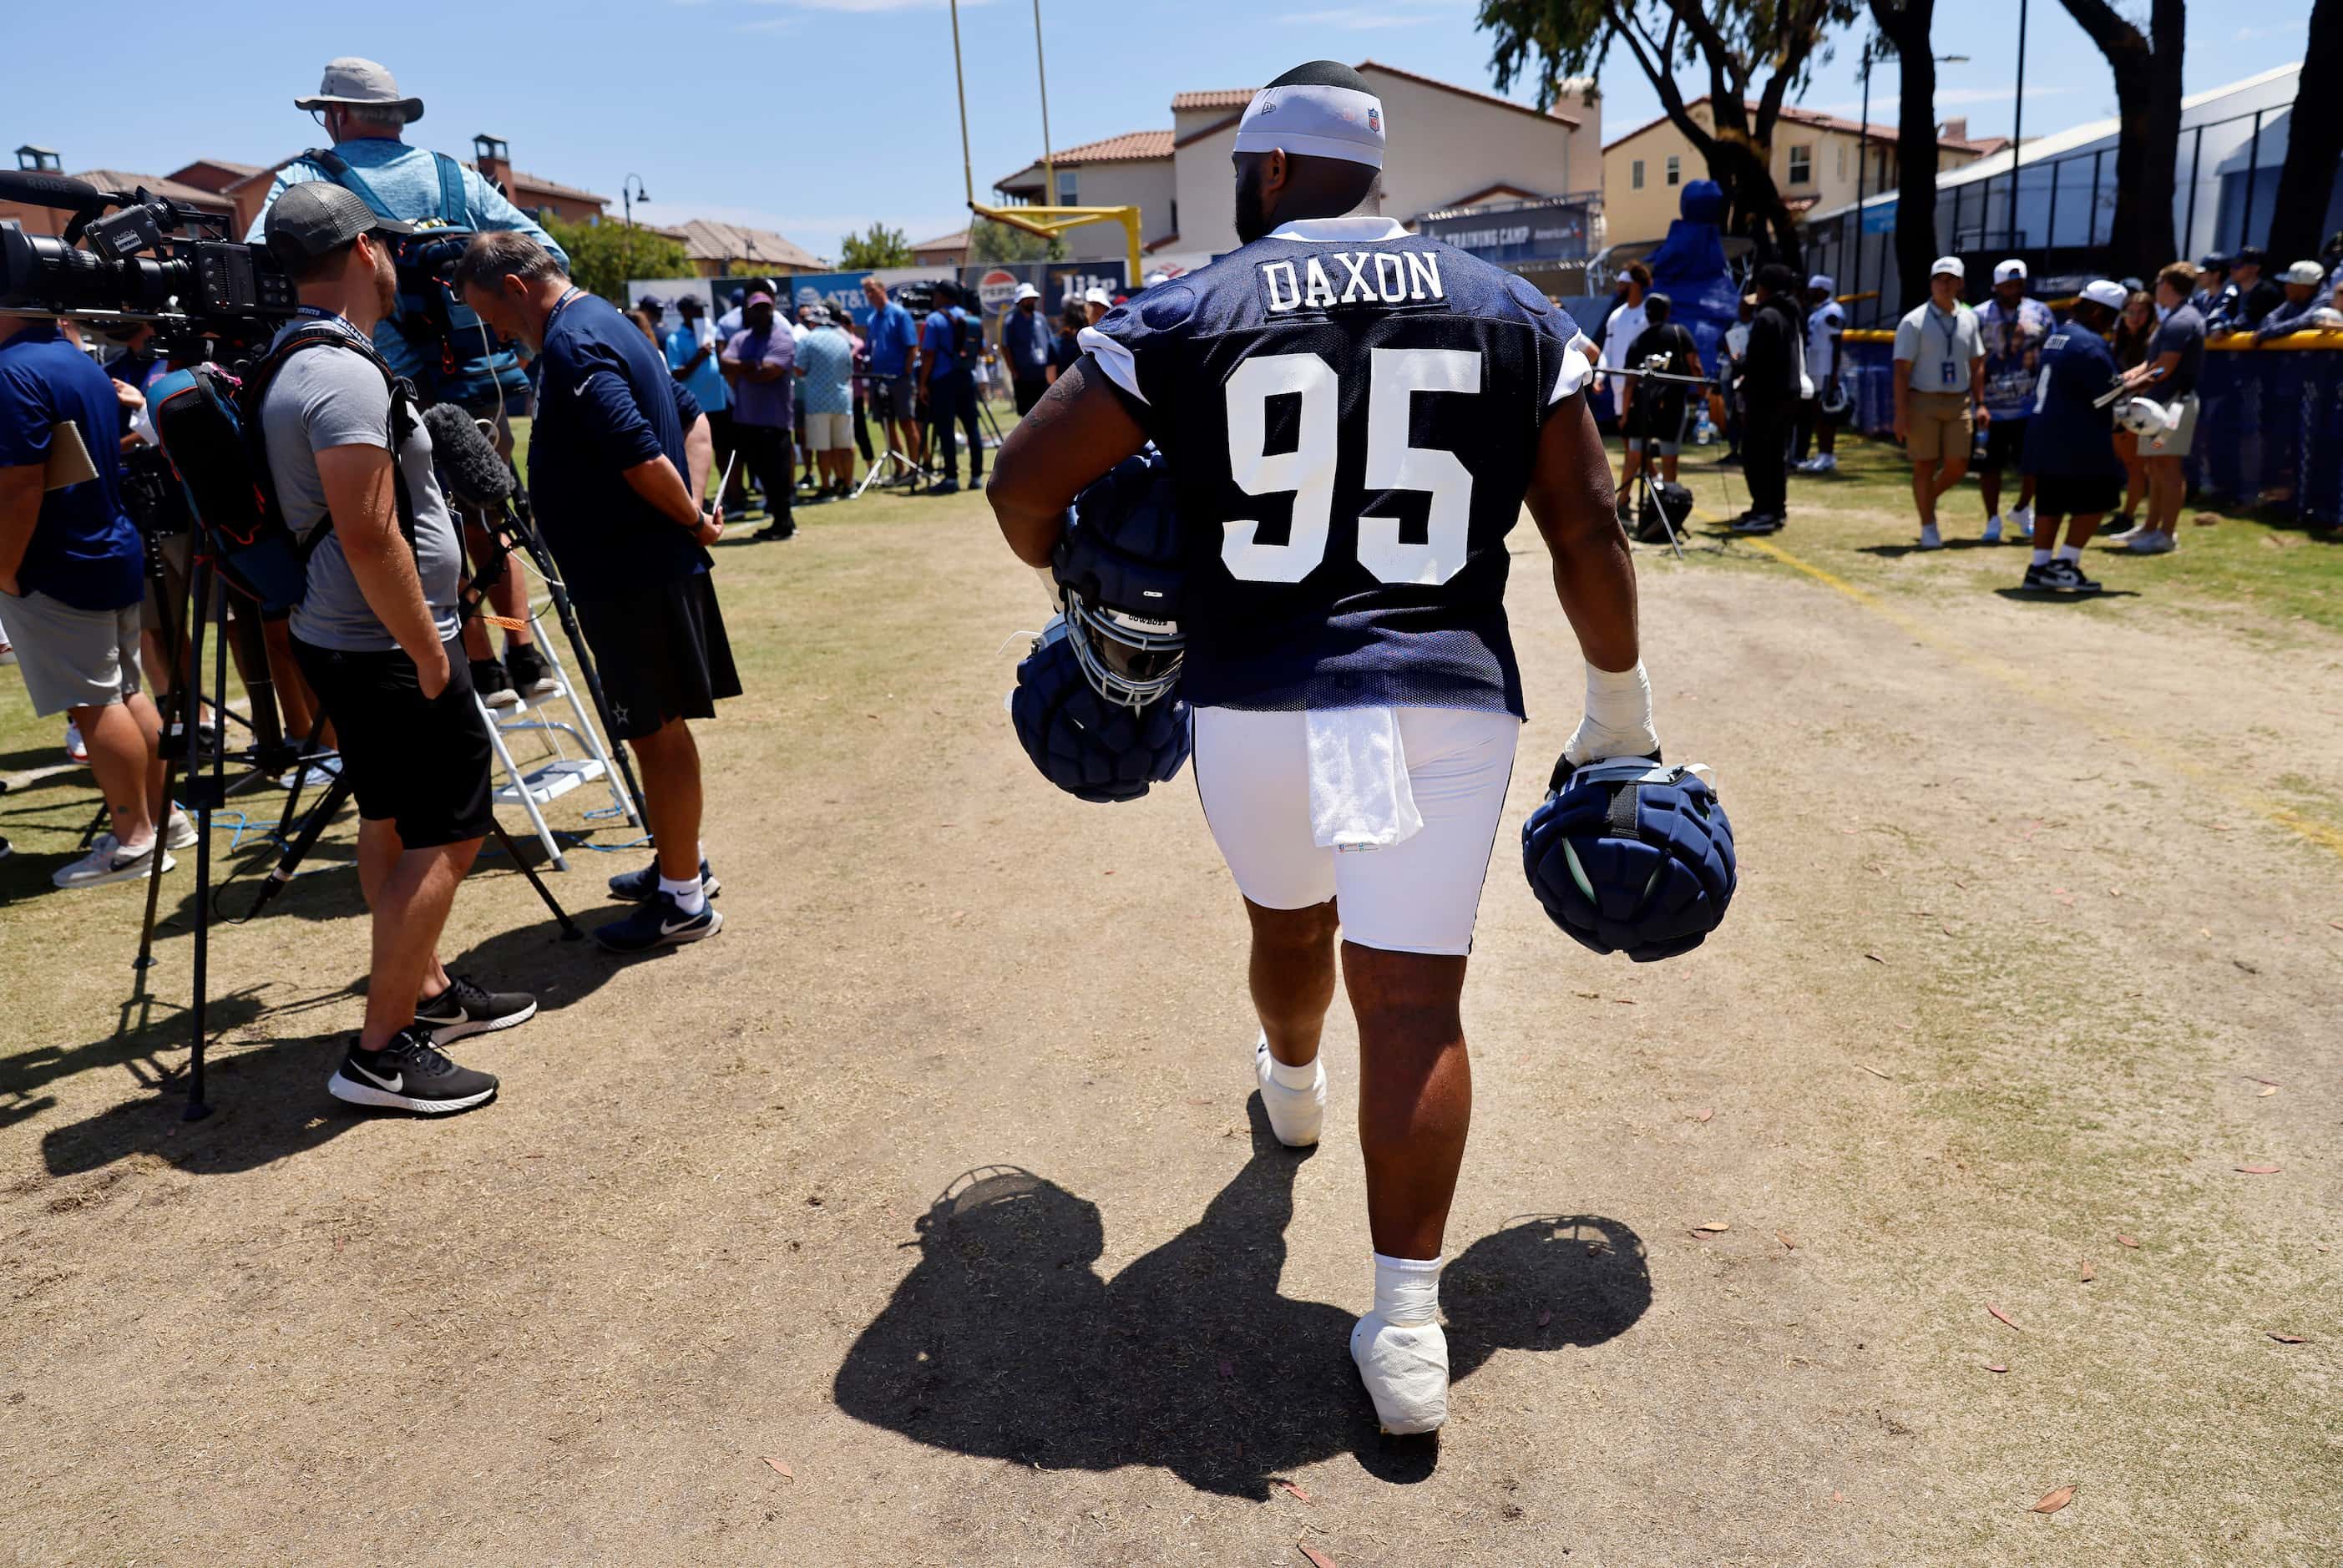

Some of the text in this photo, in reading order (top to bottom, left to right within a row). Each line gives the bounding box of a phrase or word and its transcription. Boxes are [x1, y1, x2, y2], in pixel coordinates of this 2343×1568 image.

[1445, 225, 1530, 249] TRAINING CAMP
[1263, 251, 1445, 312] DAXON
[1221, 347, 1481, 585] 95
